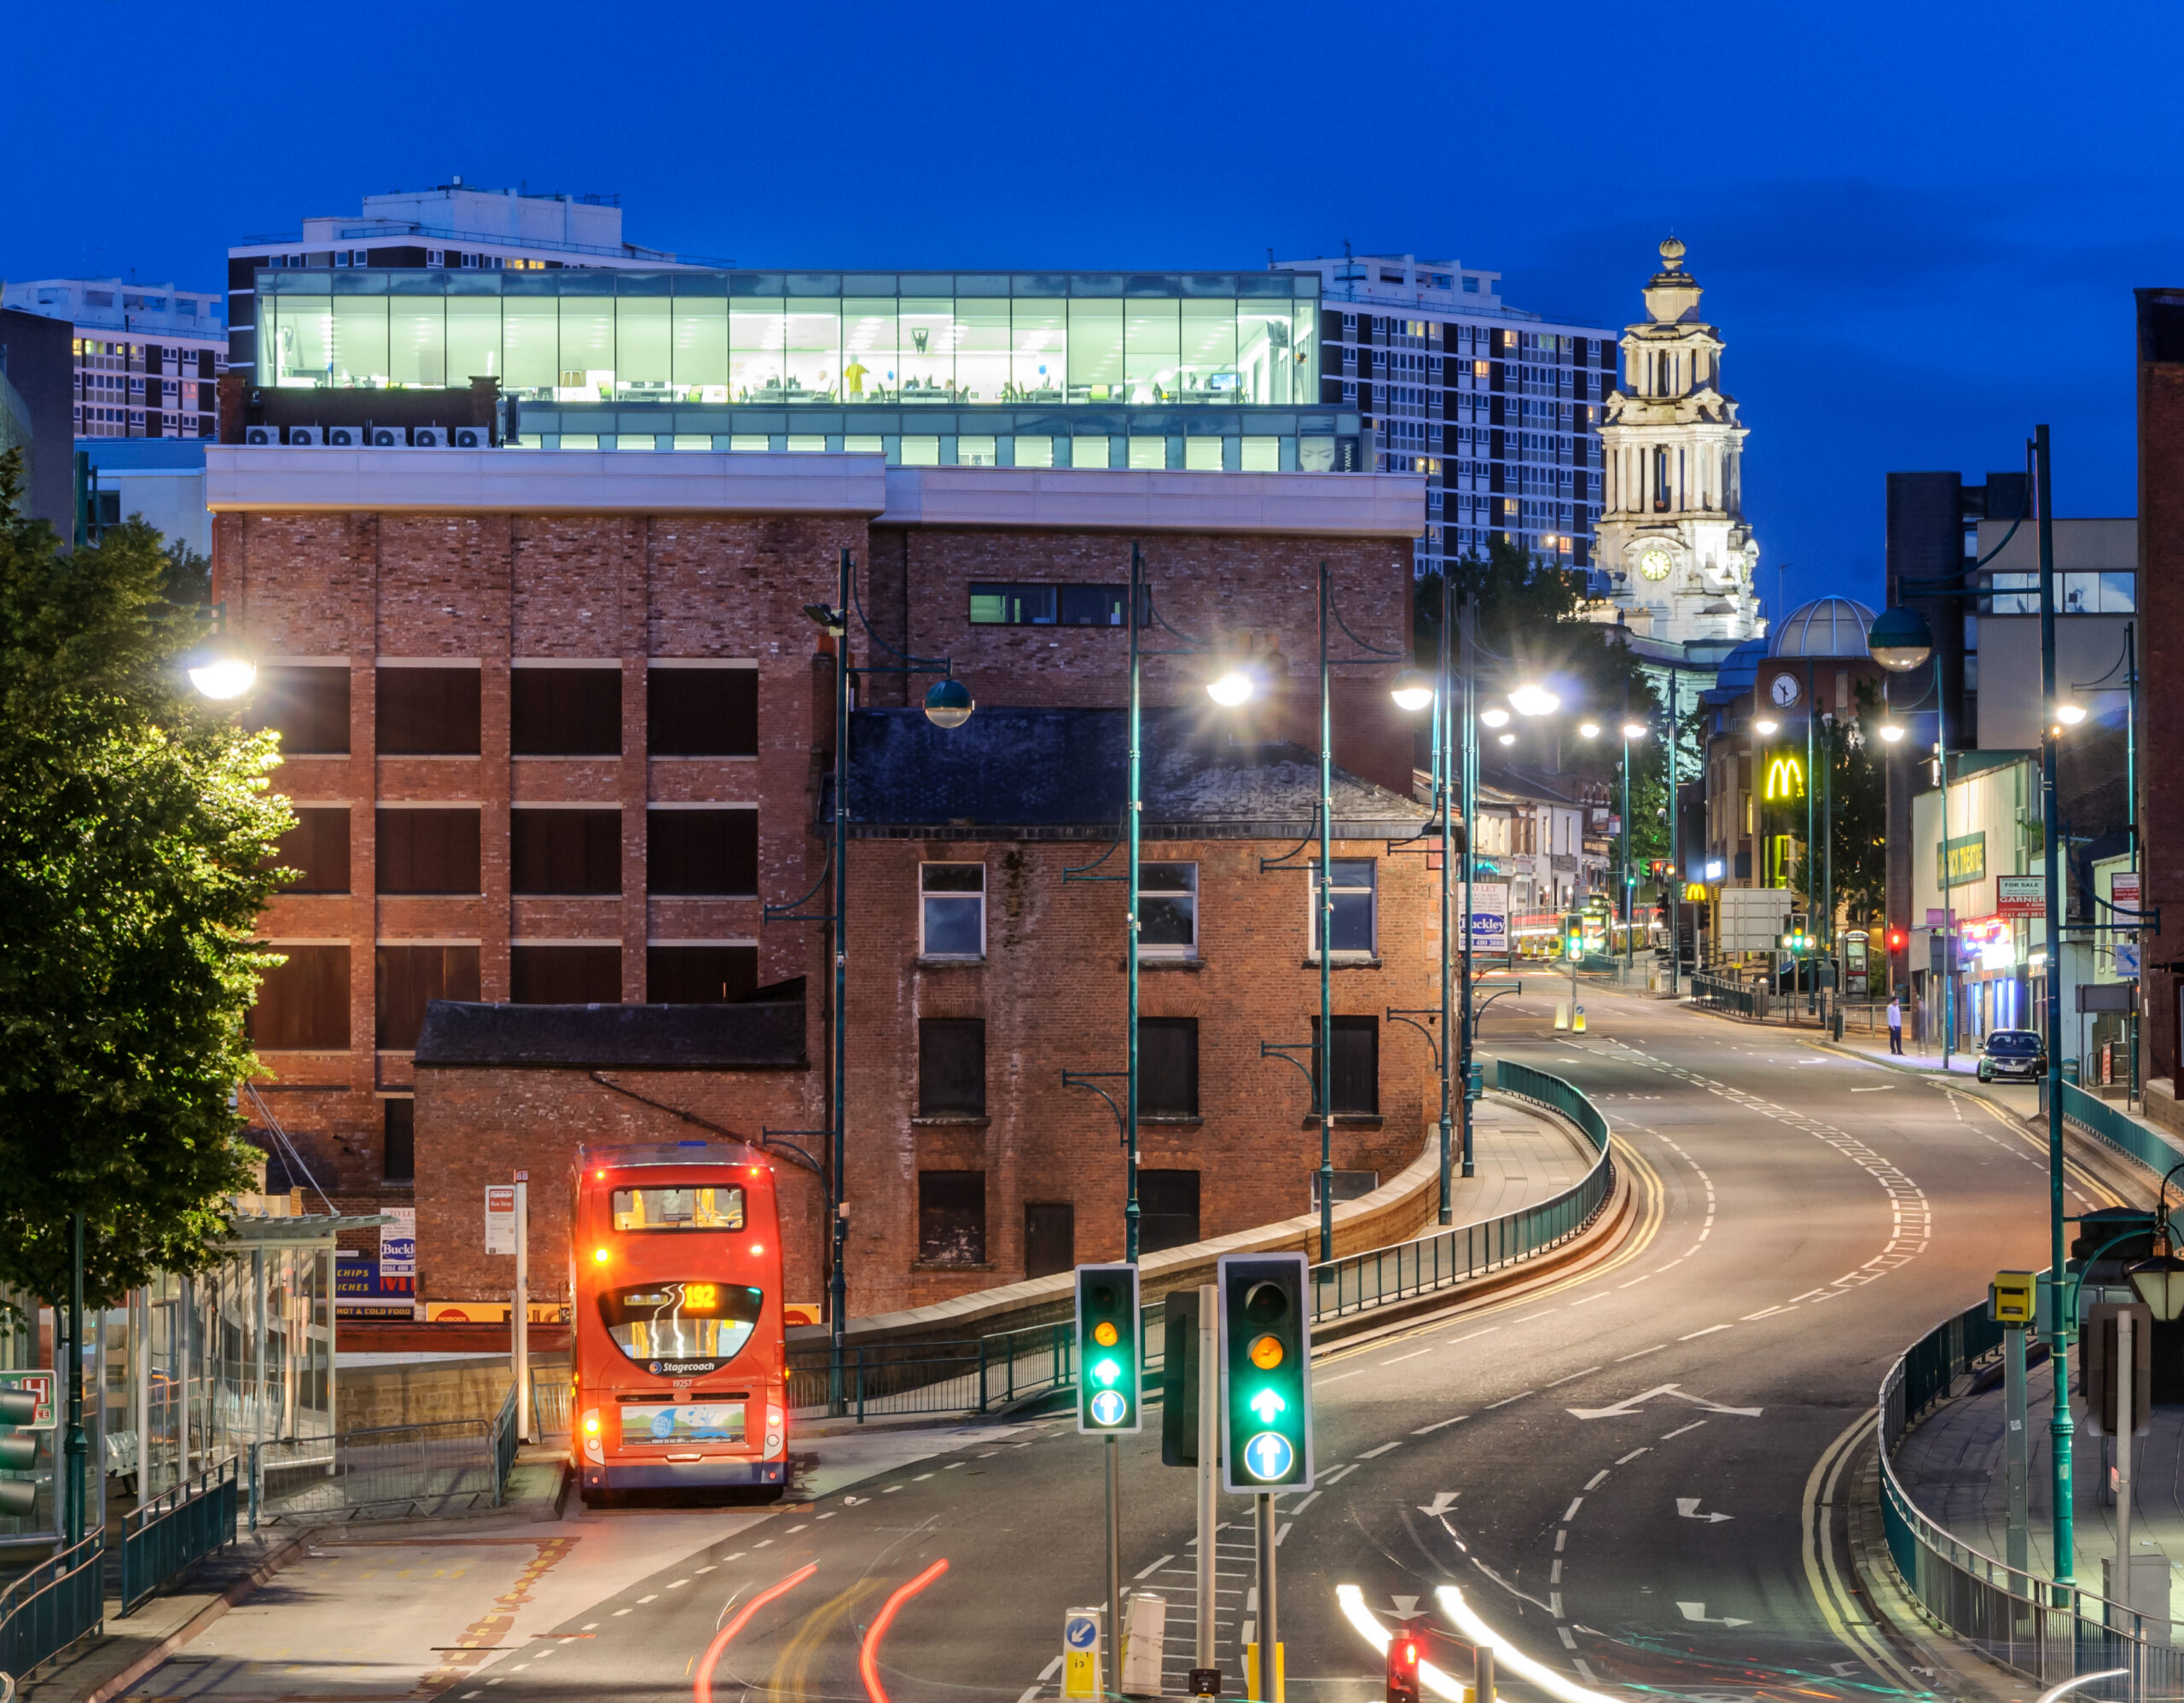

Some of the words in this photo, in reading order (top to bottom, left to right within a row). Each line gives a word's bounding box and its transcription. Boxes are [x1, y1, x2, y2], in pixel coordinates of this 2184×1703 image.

[383, 1243, 415, 1254] Buckl
[685, 1286, 716, 1308] 192
[663, 1362, 715, 1374] Stagecoach
